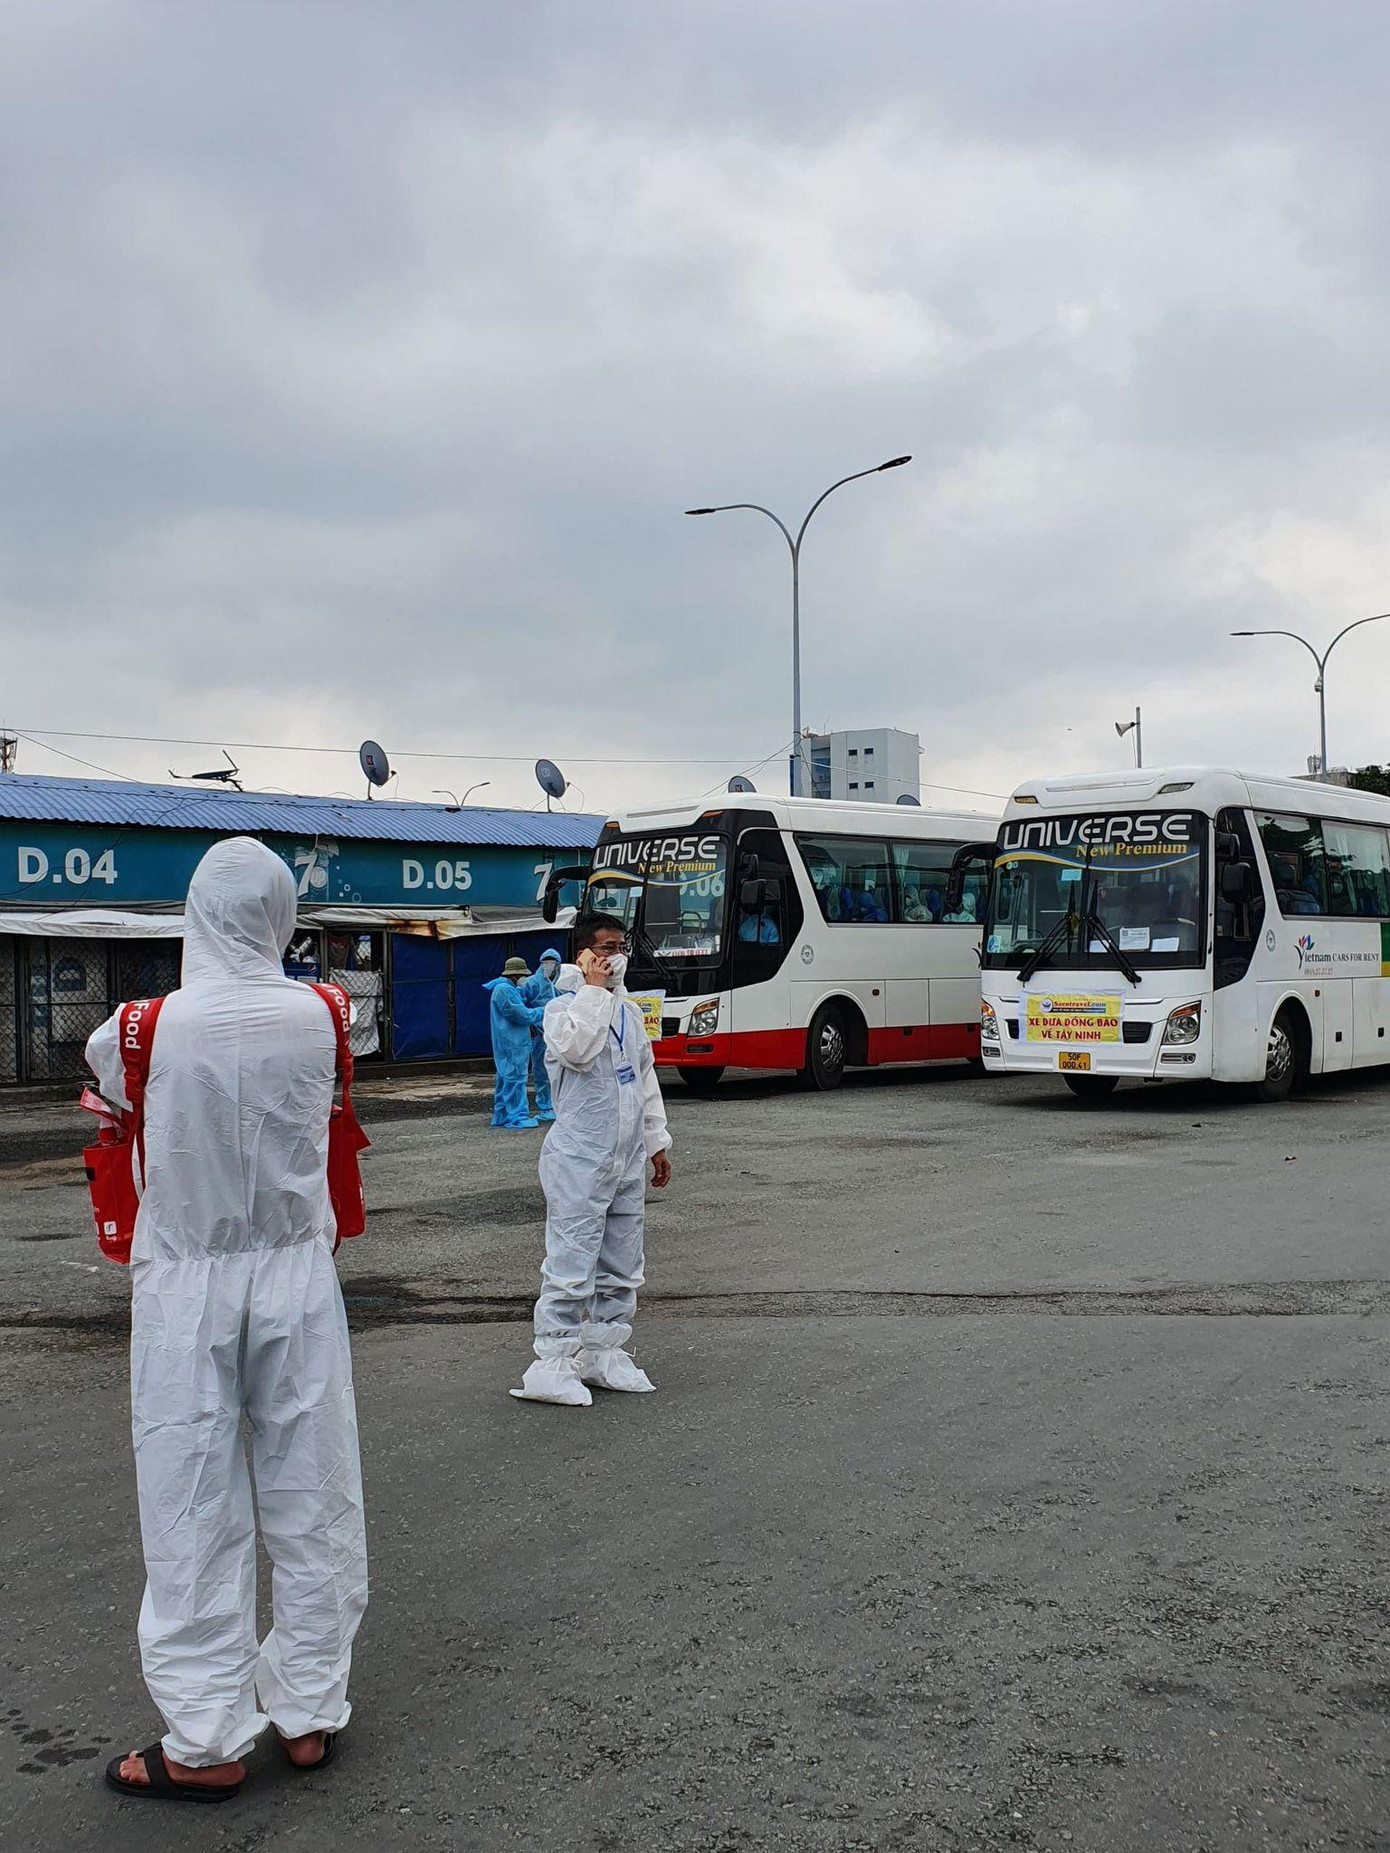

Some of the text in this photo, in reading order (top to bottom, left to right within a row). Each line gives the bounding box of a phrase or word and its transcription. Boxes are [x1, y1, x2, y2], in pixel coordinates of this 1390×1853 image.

[1003, 814, 1192, 850] UNIVERSE
[593, 836, 720, 870] UNIVERSE
[1075, 841, 1187, 858] New Premium
[18, 846, 118, 885] D.04
[403, 859, 472, 890] D.05
[638, 859, 716, 874] New Premium
[1332, 953, 1350, 962] CARS
[1351, 953, 1362, 962] FOR
[1363, 952, 1380, 962] RENT
[125, 1002, 150, 1049] Food
[1028, 1018, 1040, 1026] XE
[1075, 1031, 1101, 1040] NINH
